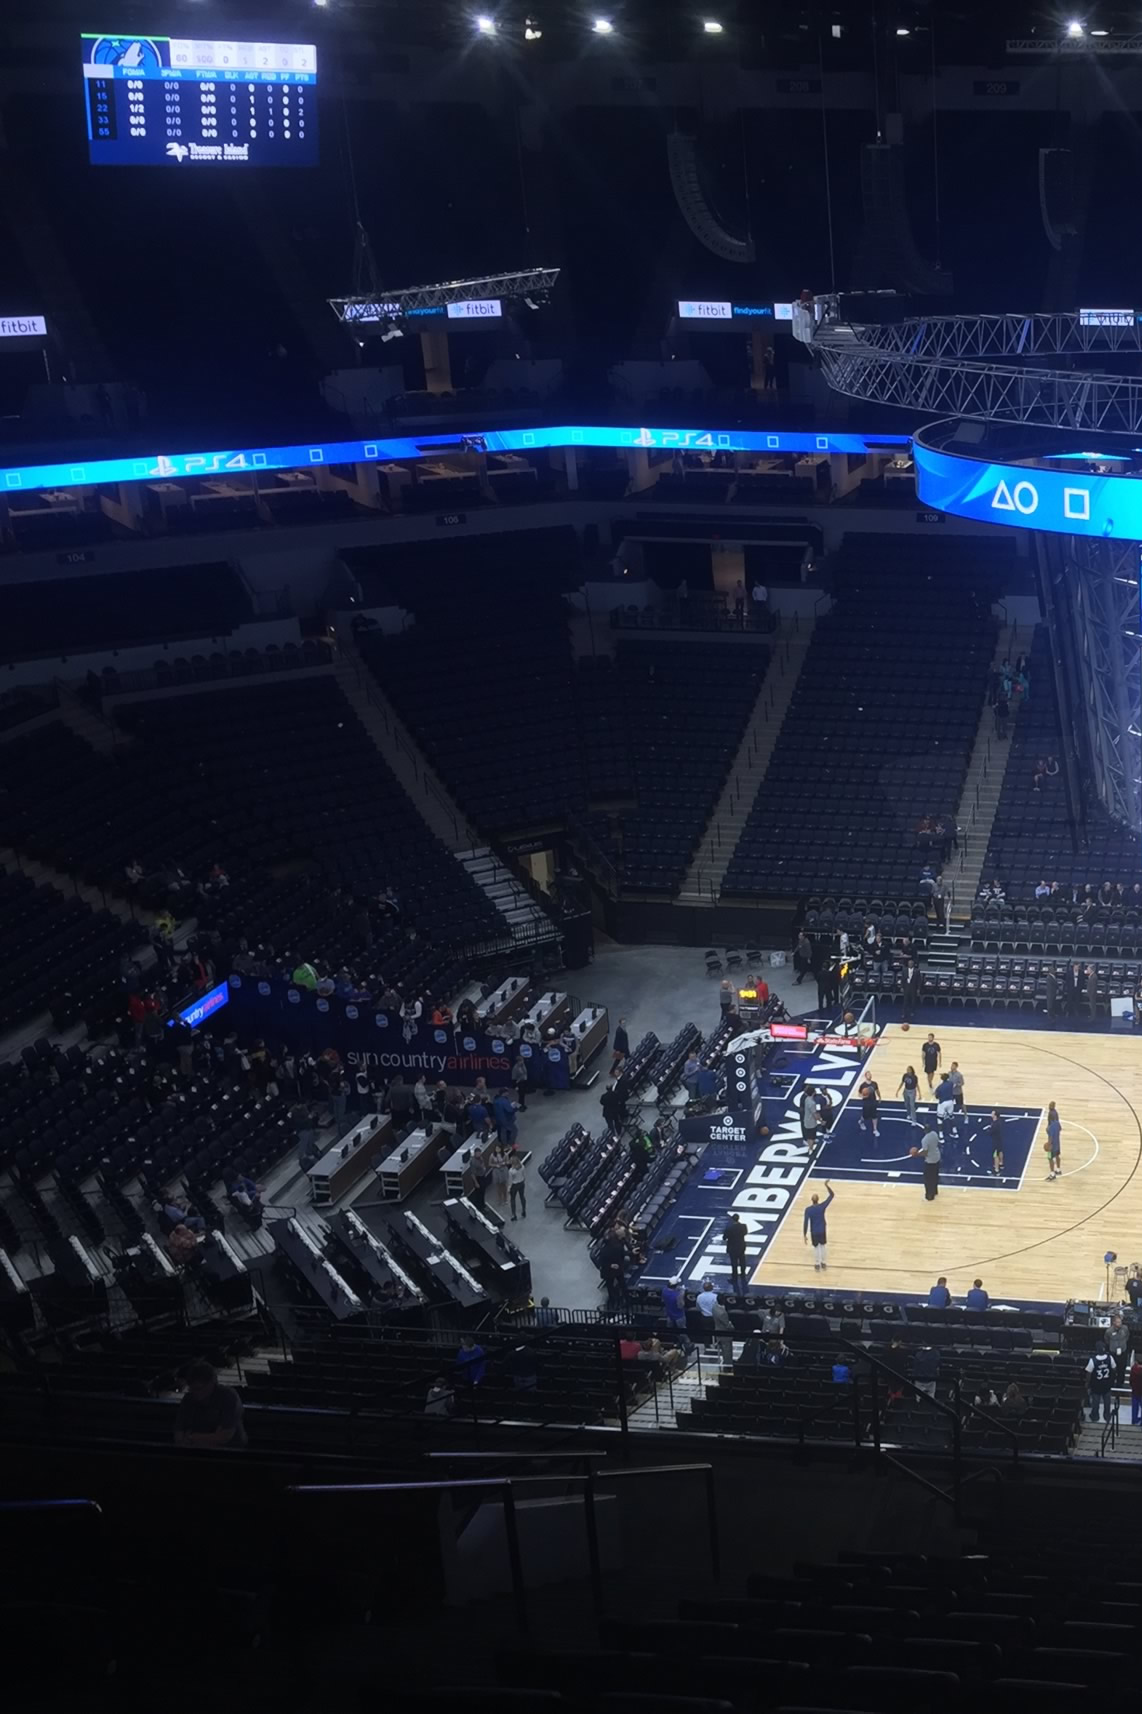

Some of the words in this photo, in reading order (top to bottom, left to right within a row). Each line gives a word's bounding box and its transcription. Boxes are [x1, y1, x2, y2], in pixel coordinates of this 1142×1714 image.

[223, 56, 229, 64] 0
[263, 57, 269, 65] 2
[282, 58, 288, 66] 0
[301, 59, 307, 67] 2
[127, 80, 143, 89] 0/0
[164, 82, 179, 90] 0/0
[199, 82, 215, 91] 0/0
[230, 83, 236, 91] 0
[248, 83, 255, 92] 0
[267, 84, 273, 92] 0
[282, 84, 289, 94] 0
[297, 85, 303, 93] 0
[986, 82, 1007, 94] 209
[128, 91, 144, 101] 0/0
[165, 93, 180, 101] 0/0
[200, 94, 216, 103] 0/0
[230, 95, 236, 103] 0
[249, 95, 255, 104] 1
[267, 96, 273, 104] 0
[282, 96, 289, 105] 0
[298, 97, 304, 105] 0
[129, 104, 145, 113] 1/2
[165, 105, 180, 113] 0/0
[201, 105, 217, 115] 0/0
[231, 106, 237, 115] 0
[250, 106, 255, 116] 1
[283, 107, 290, 117] 0
[298, 108, 304, 116] 2
[129, 115, 146, 125] 0/0
[166, 117, 181, 125] 0/0
[201, 117, 217, 126] 0/0
[231, 118, 237, 126] 0
[249, 118, 257, 127] 0
[268, 119, 274, 127] 0
[283, 119, 290, 128] 0
[299, 120, 305, 128] 0
[130, 127, 146, 137] 0/0
[166, 129, 182, 137] 0/0
[201, 128, 218, 138] 0/0
[232, 129, 238, 138] 0
[250, 129, 257, 139] 0
[269, 130, 274, 138] 0
[284, 130, 291, 139] 0
[299, 131, 305, 139] 0
[466, 303, 495, 315] fitbit
[698, 304, 726, 316] fitbit
[1, 319, 38, 333] fitbit
[662, 432, 714, 446] PS4
[183, 453, 249, 472] PS4
[67, 553, 85, 563] 104
[709, 1126, 746, 1135] TARGET
[709, 1133, 746, 1142] CENTER
[1096, 1368, 1110, 1380] 32
